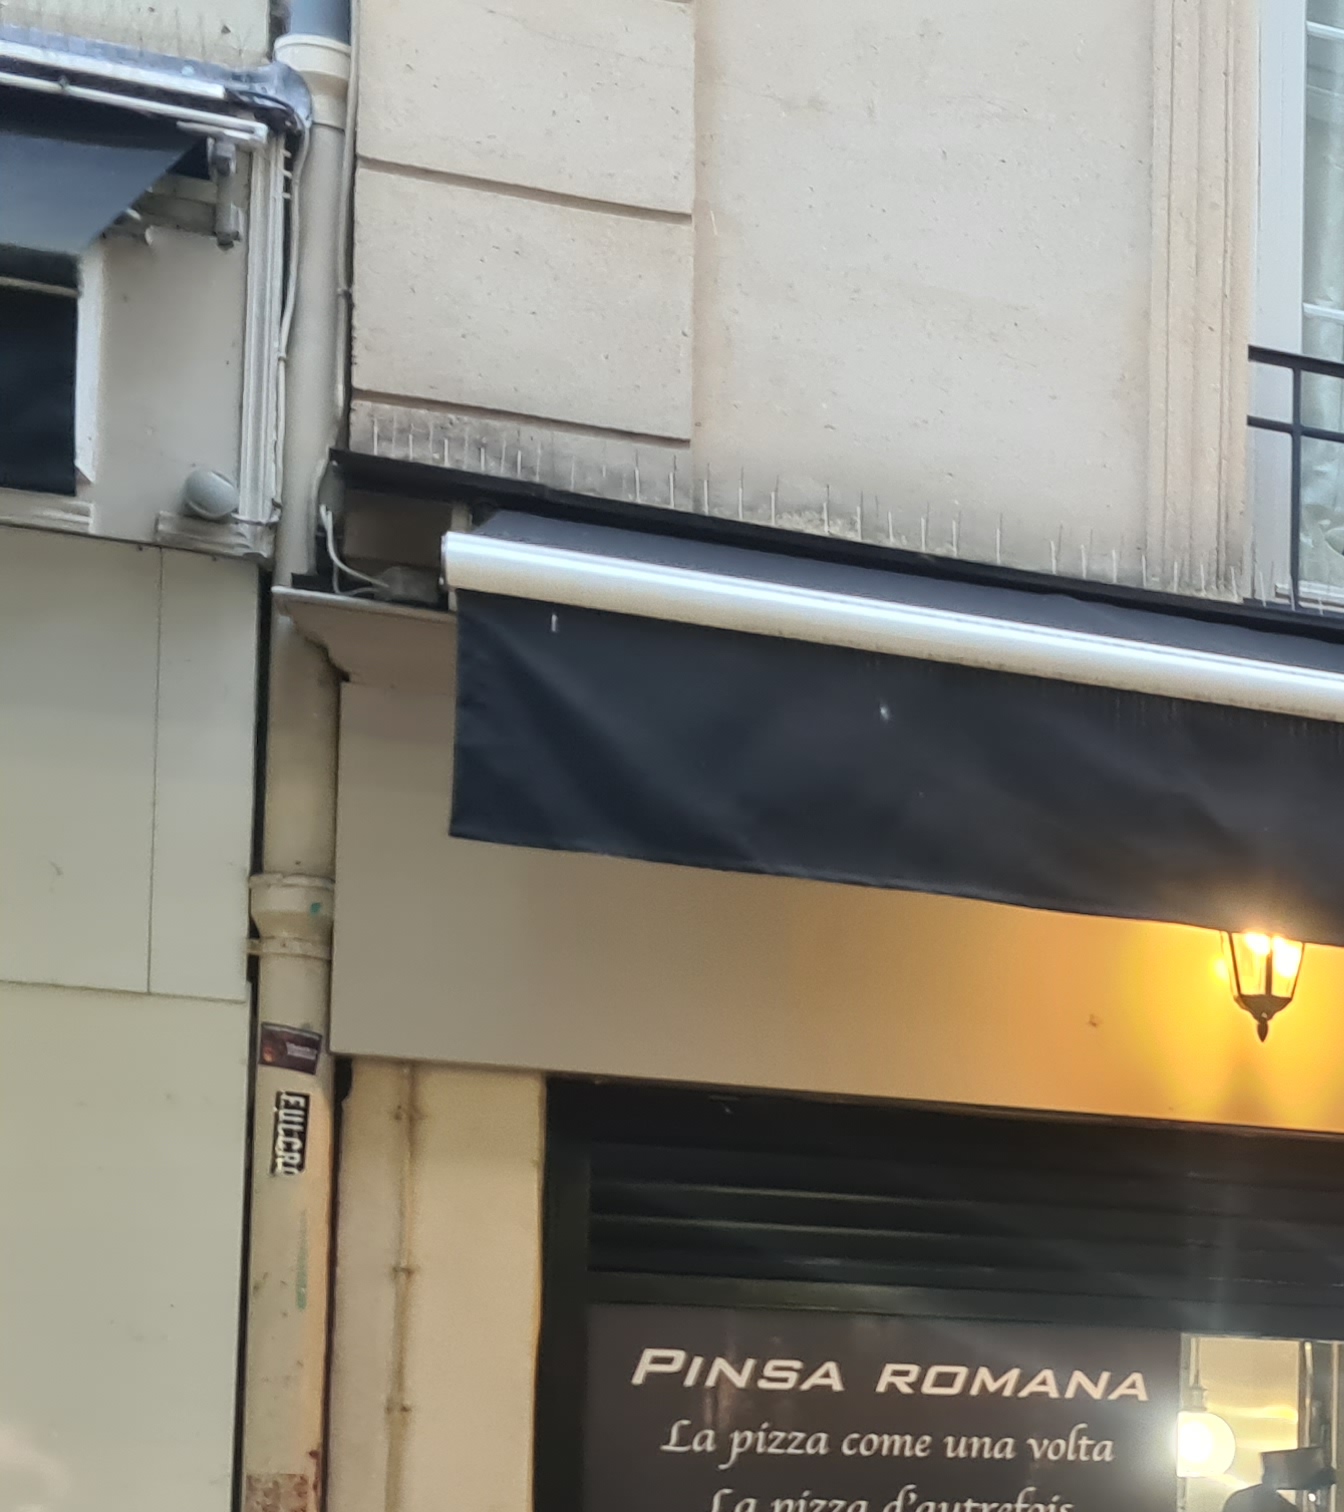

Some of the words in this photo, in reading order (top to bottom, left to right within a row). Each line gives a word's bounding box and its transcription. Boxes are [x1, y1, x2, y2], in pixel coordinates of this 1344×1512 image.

[630, 1348, 845, 1392] PINSA
[875, 1362, 1150, 1401] ROMANA
[660, 1419, 717, 1454] La
[718, 1423, 830, 1470] pizza
[840, 1430, 932, 1459] come
[944, 1434, 1016, 1462] una
[1026, 1422, 1115, 1462] volta
